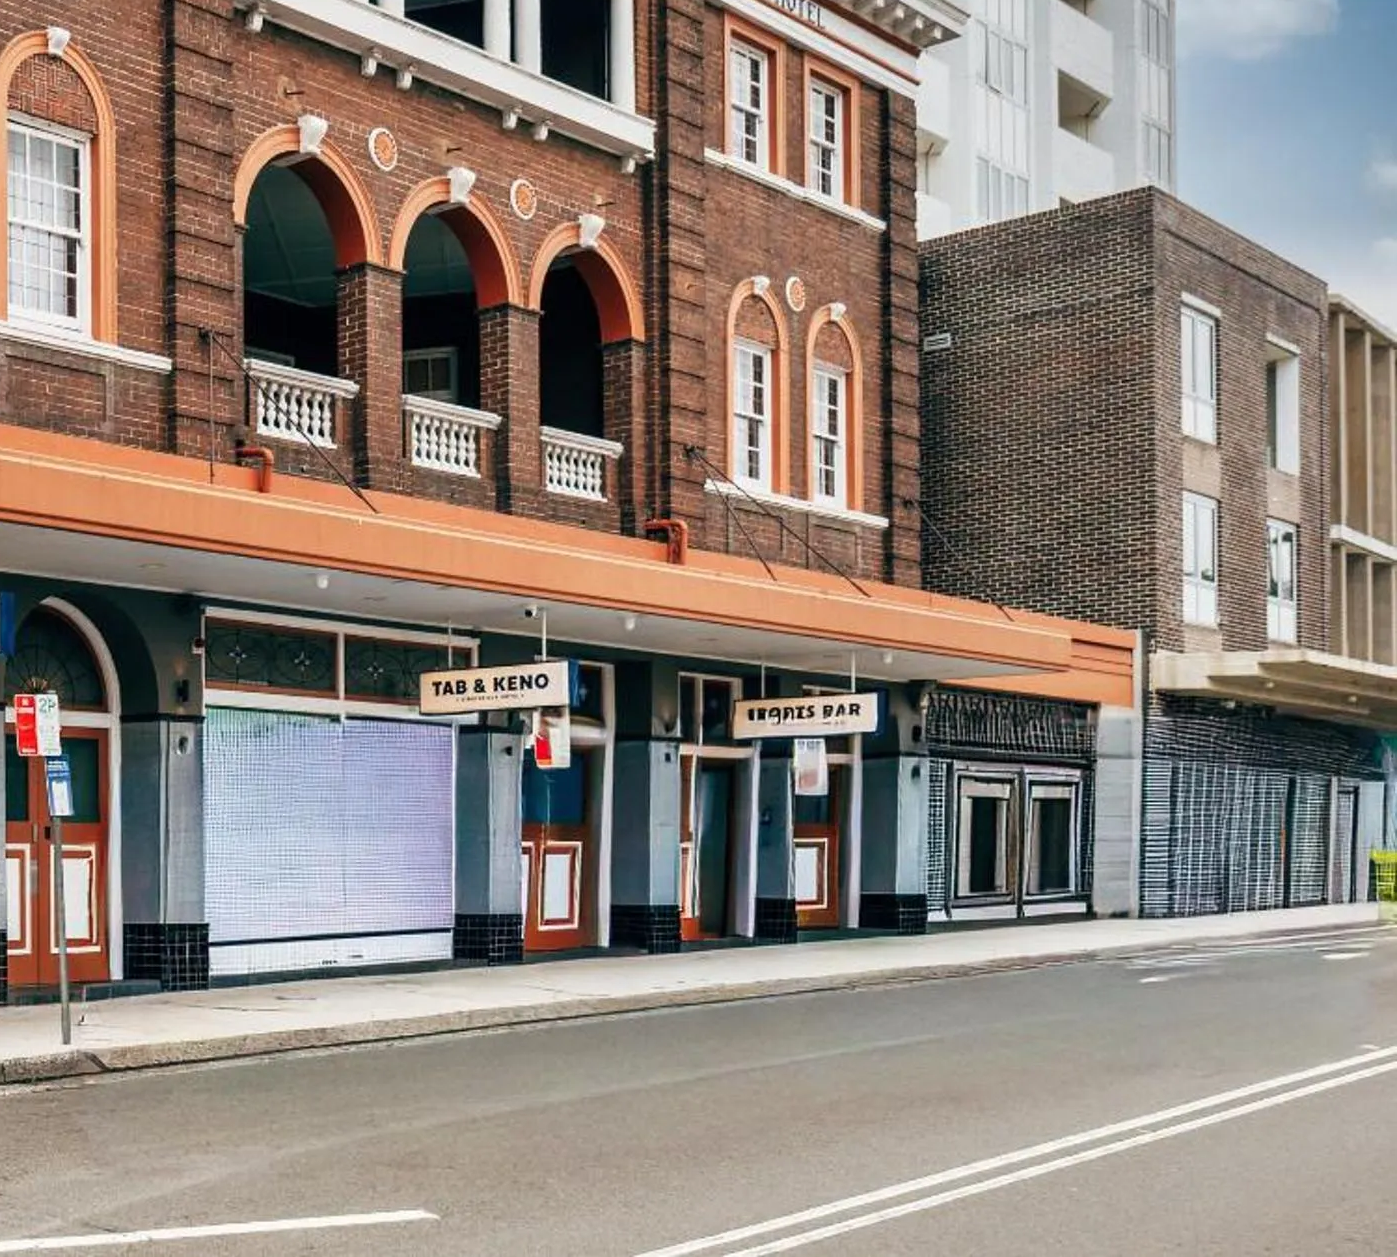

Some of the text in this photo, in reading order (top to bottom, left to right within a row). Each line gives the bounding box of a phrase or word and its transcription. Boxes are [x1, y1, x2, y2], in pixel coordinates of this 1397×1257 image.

[432, 673, 549, 697] TAB & KENO
[822, 703, 861, 719] BAR
